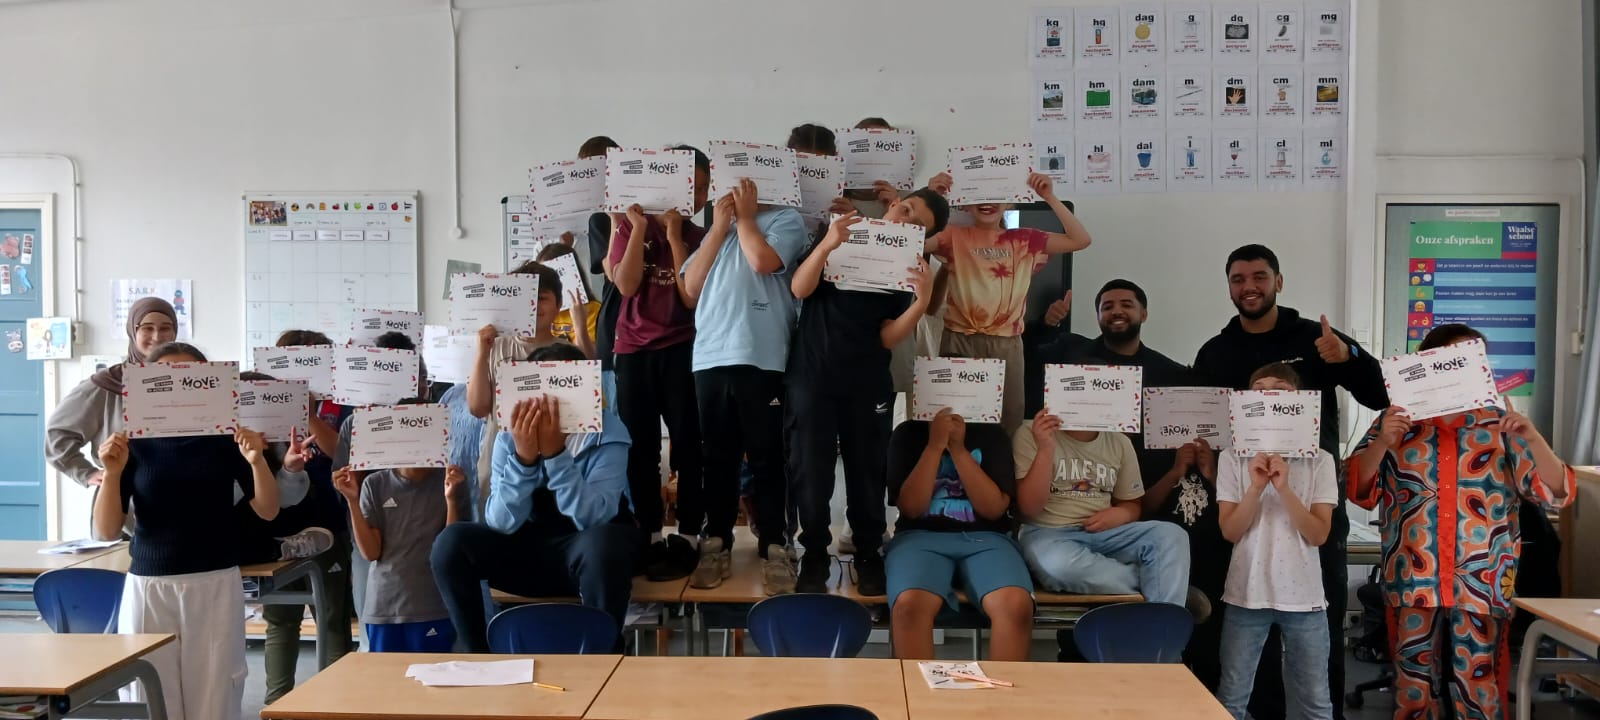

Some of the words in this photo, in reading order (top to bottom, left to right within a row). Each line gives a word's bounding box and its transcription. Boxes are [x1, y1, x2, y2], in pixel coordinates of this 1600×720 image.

[1046, 18, 1059, 27] kg
[1092, 18, 1106, 27] hg
[1135, 13, 1155, 22] dag
[1230, 14, 1244, 22] dg
[1276, 14, 1290, 22] cg
[1320, 13, 1337, 21] mg
[1044, 82, 1060, 90] km
[1089, 80, 1105, 88] hm
[1132, 78, 1155, 86] dam
[1227, 77, 1243, 85] dm
[875, 139, 901, 152] MOVE
[1047, 145, 1057, 153] kl
[1230, 140, 1239, 148] dl
[755, 155, 781, 168] MOVE
[990, 155, 1017, 166] MOVE
[649, 162, 675, 174] MOVE
[800, 165, 826, 179] MOVE
[570, 169, 596, 181] MOVE
[1507, 225, 1535, 233] Waalse
[875, 234, 905, 247] MOVE
[1415, 235, 1442, 245] Onze
[1444, 235, 1494, 247] afspraken
[1508, 232, 1534, 240] school
[491, 286, 518, 297] MOVE
[386, 319, 409, 330] MOVE
[294, 356, 320, 367] MOVE
[373, 360, 402, 372] MOVE
[1433, 358, 1465, 371] MOVE
[548, 375, 580, 387] MOVE
[958, 371, 986, 382] MOVE
[182, 376, 217, 389] MOVE
[1092, 378, 1121, 390] MOVE
[262, 392, 291, 404] MOVE
[1272, 403, 1301, 415] MOVE
[400, 416, 430, 428] MOVE
[1053, 457, 1118, 488] AKERS
